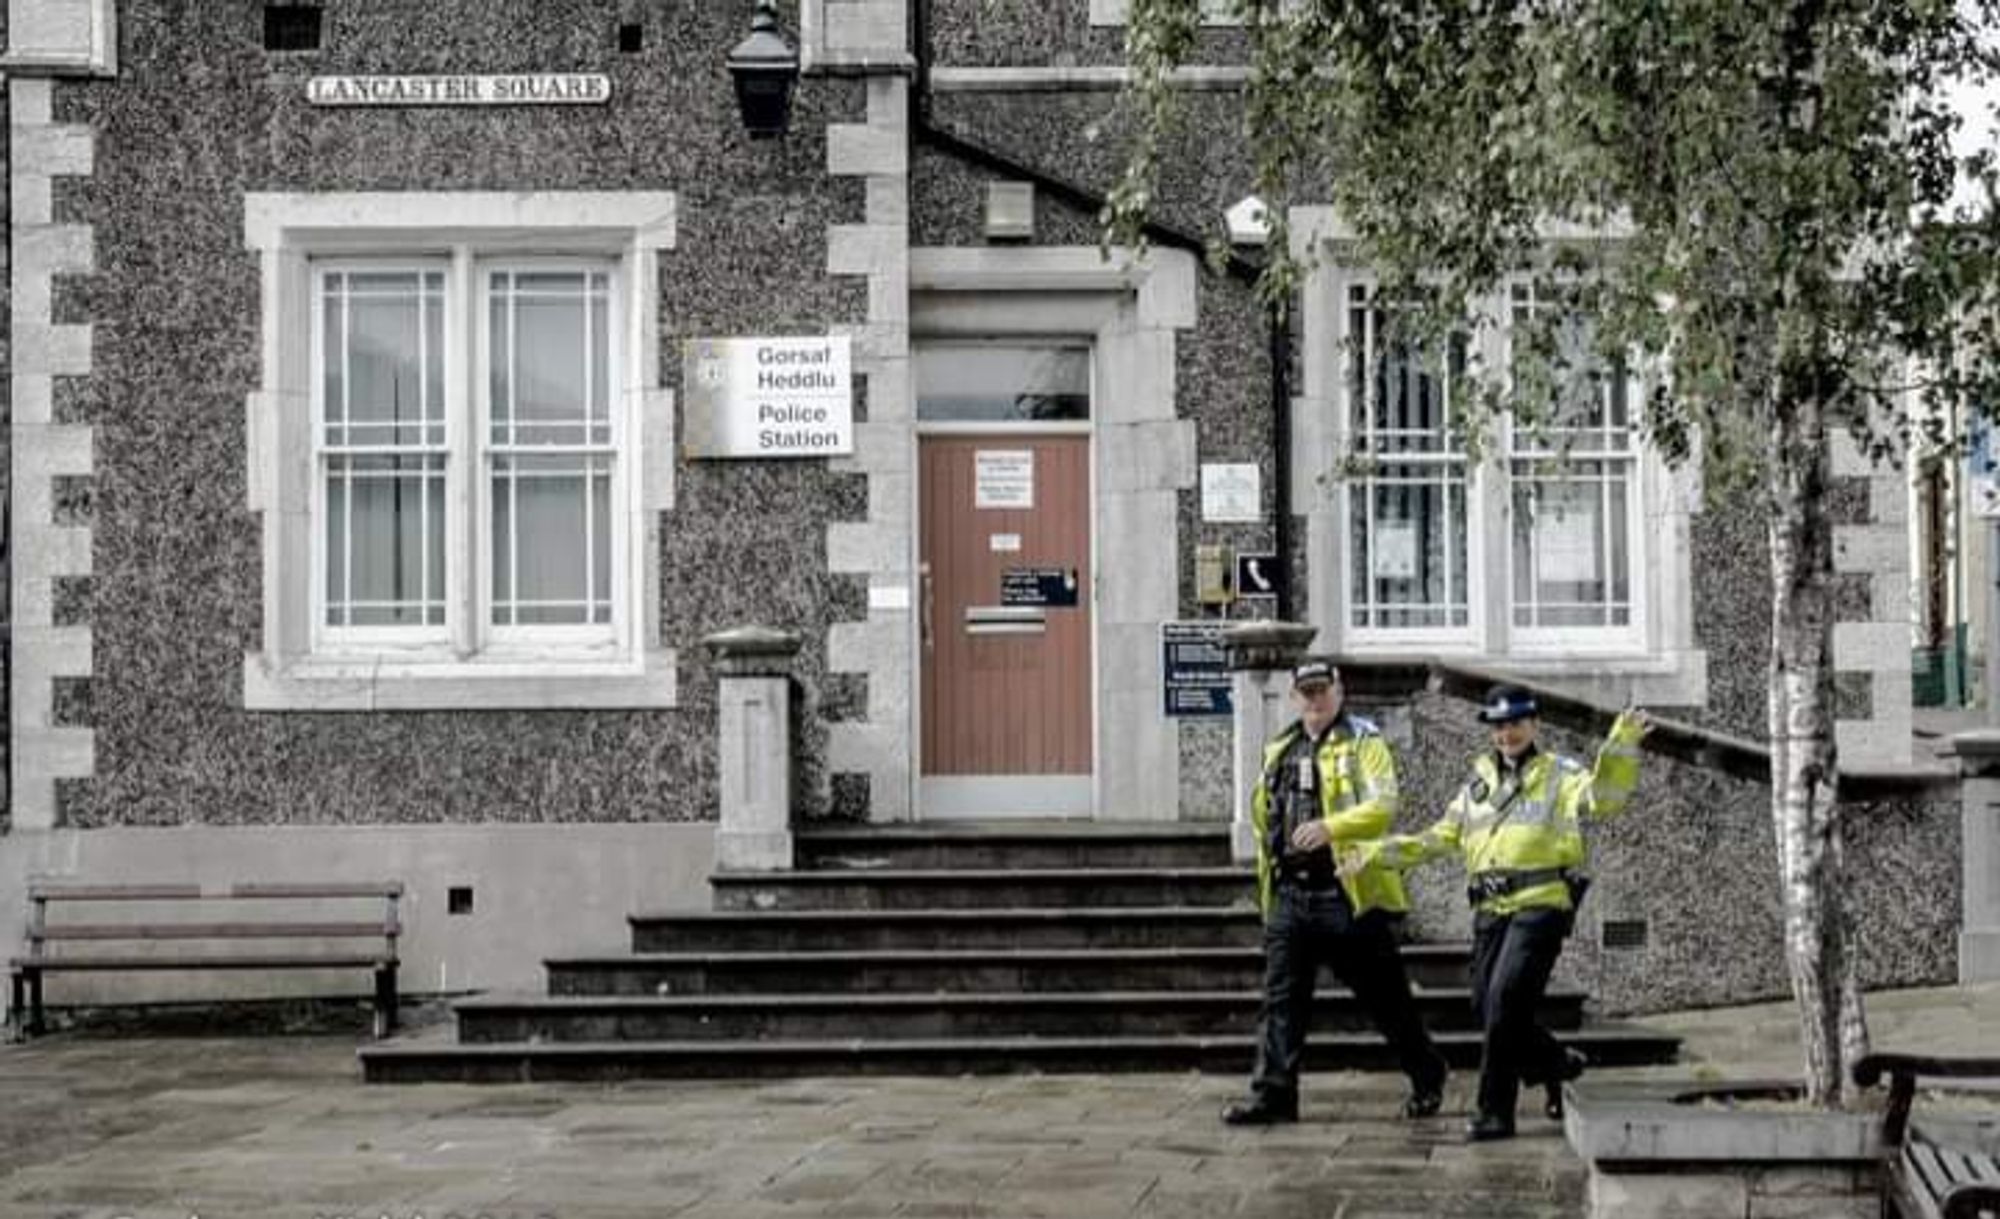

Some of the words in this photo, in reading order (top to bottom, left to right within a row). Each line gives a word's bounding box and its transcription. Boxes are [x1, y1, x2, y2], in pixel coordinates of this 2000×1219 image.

[312, 78, 479, 99] LANCASTER
[492, 77, 604, 98] SQUARE
[757, 347, 831, 365] Gorsaf
[757, 371, 836, 390] Heddlu
[758, 403, 827, 423] Police
[758, 429, 839, 449] Station
